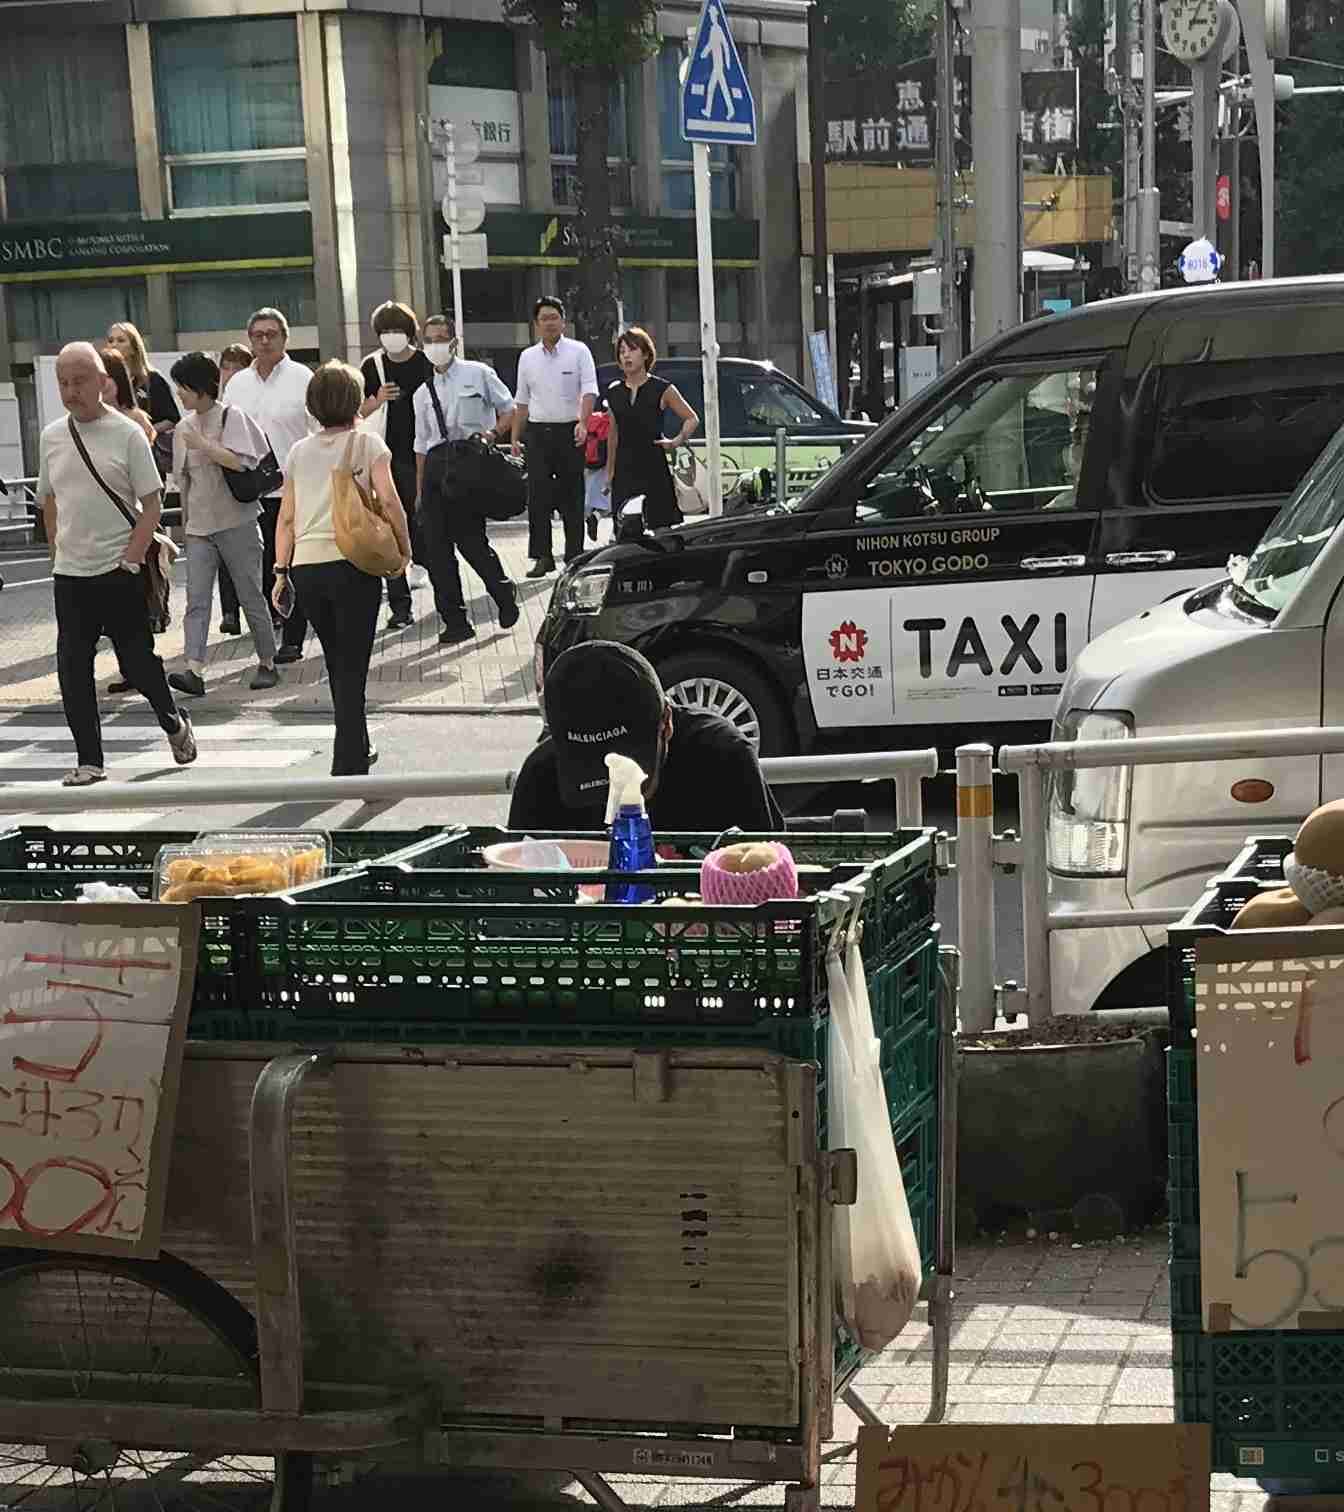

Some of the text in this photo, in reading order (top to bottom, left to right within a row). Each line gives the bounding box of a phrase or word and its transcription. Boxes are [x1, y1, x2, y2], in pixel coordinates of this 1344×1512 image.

[1, 238, 63, 262] SMBC
[856, 527, 1000, 551] NIHON KOTSU GROUP
[868, 554, 990, 577] TOKYO GODO
[903, 612, 1068, 679] TAXI
[817, 665, 884, 681] 日本交通
[567, 725, 628, 744] BALENCIAGA
